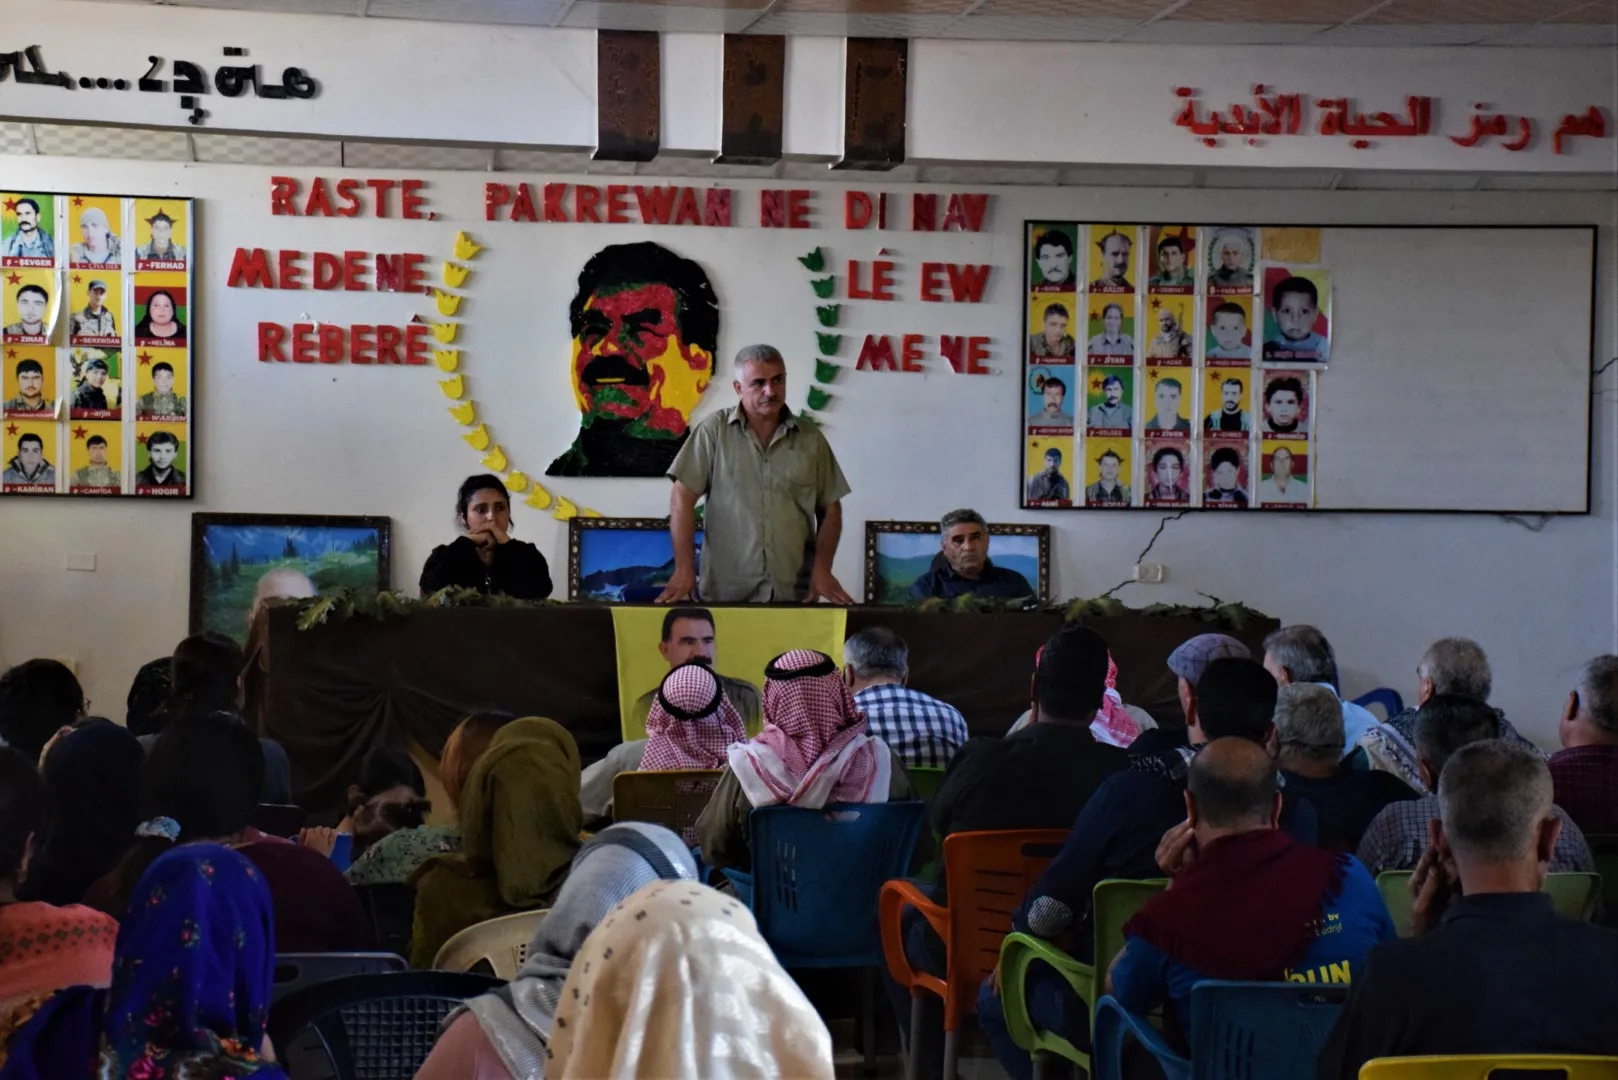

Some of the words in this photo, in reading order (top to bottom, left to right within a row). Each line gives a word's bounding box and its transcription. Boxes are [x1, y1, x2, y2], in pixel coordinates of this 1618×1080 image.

[1316, 96, 1431, 149] الحياة
[1450, 103, 1531, 151] رمز
[1554, 105, 1604, 155] هم
[484, 182, 731, 227] PAKREWAN
[760, 189, 811, 229] NE
[844, 190, 886, 230] DI
[912, 193, 989, 232] NAV
[920, 262, 991, 302] EW
